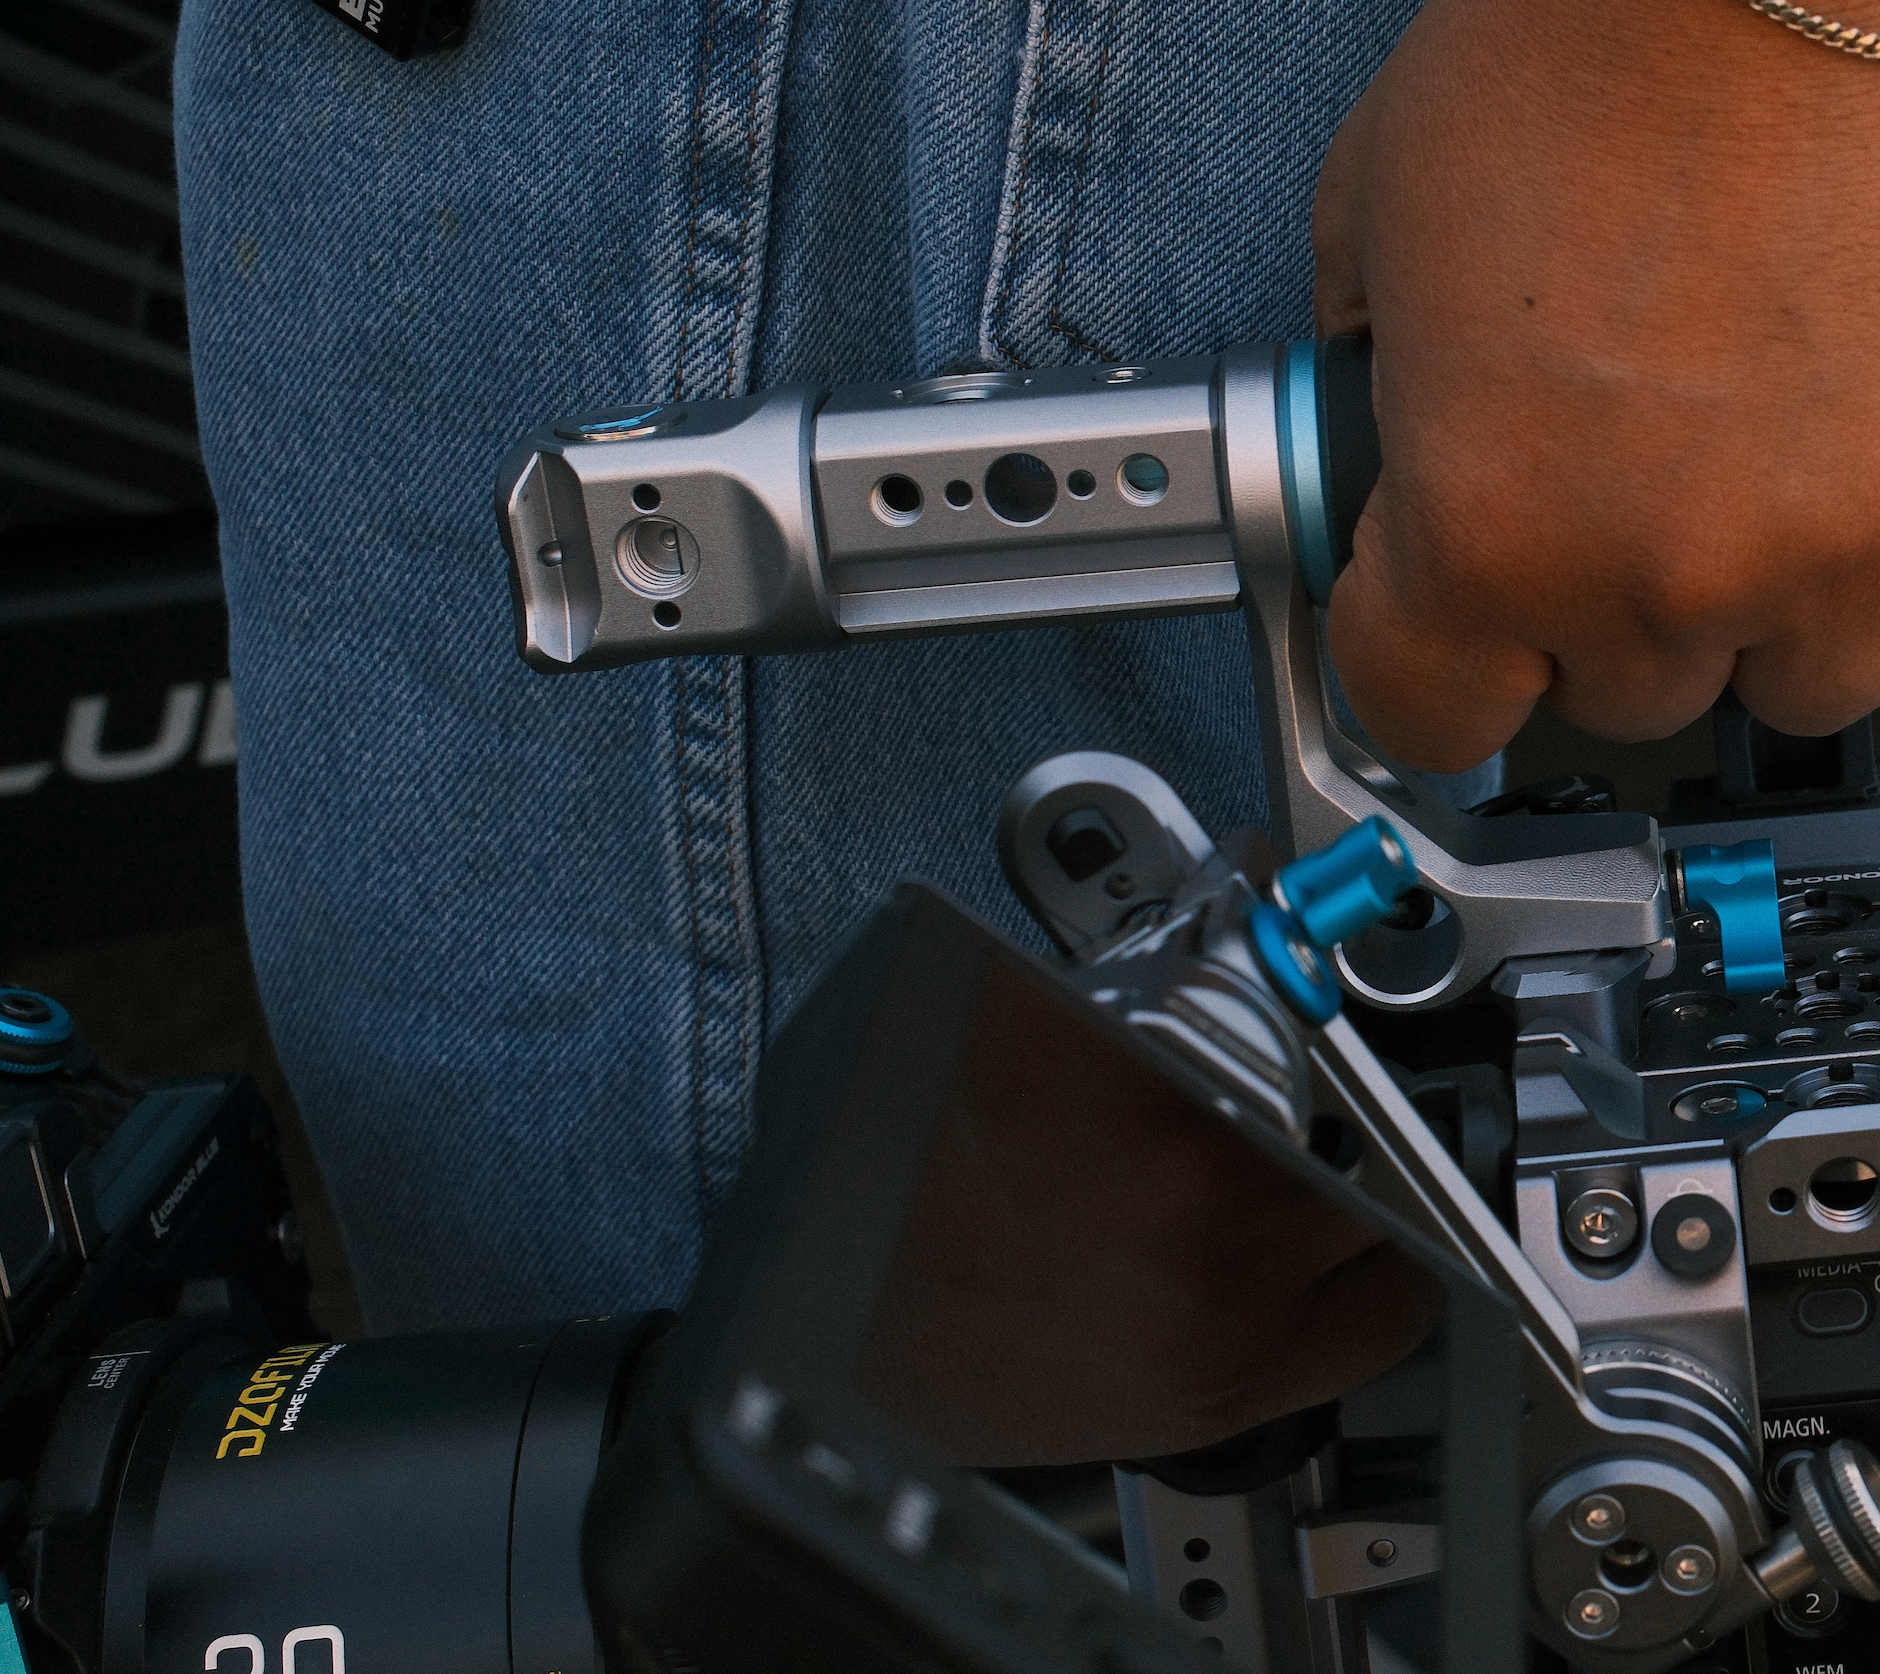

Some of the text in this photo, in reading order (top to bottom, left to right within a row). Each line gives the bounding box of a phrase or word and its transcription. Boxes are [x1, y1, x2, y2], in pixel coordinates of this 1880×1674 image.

[87, 1358, 116, 1388] LENS
[104, 1356, 131, 1389] CENTER
[279, 1393, 308, 1432] MAKE
[296, 1363, 326, 1391] YOUR
[1763, 1416, 1831, 1440] MAGN.
[1806, 1593, 1820, 1614] 2
